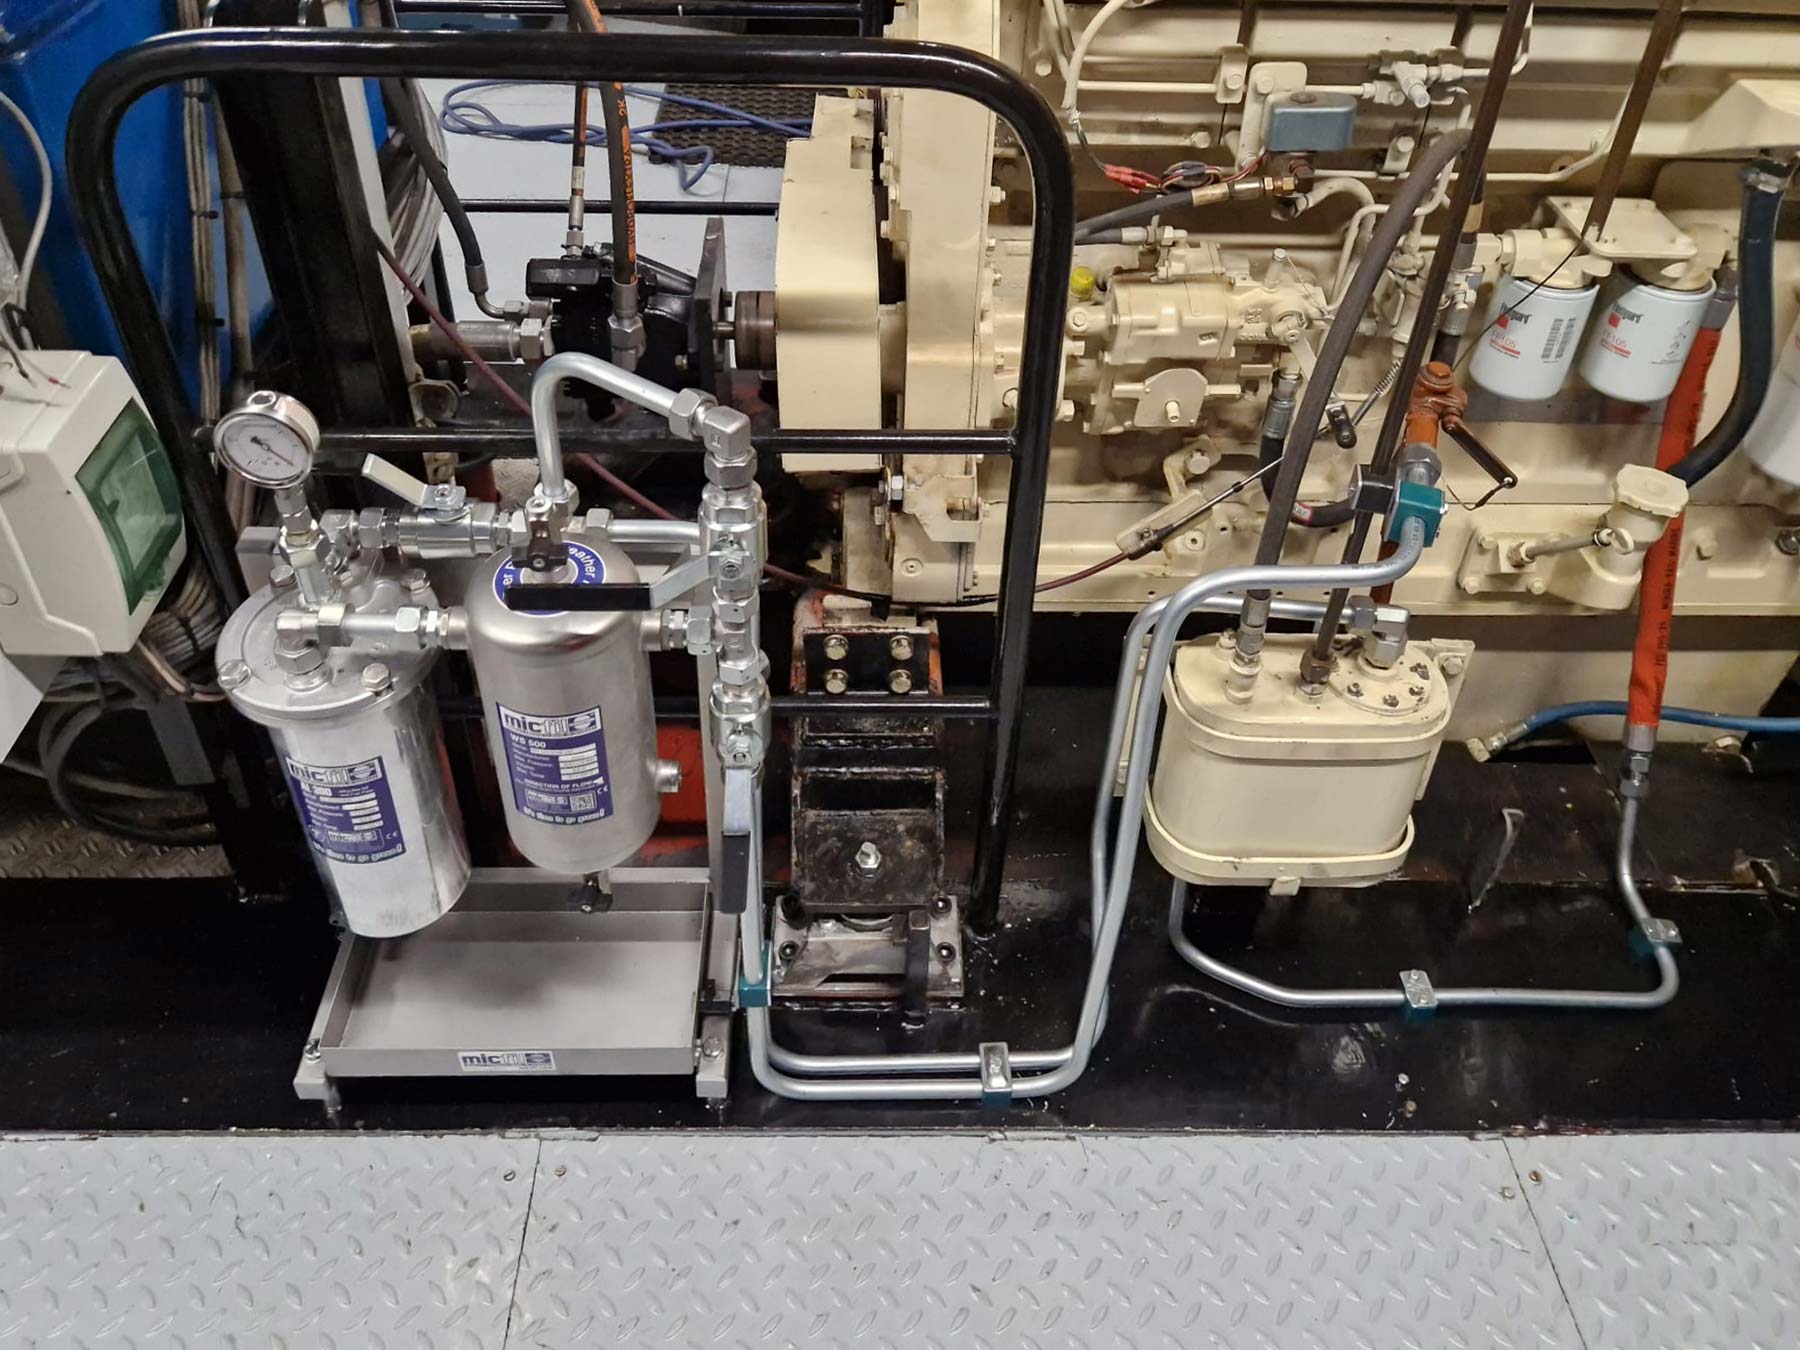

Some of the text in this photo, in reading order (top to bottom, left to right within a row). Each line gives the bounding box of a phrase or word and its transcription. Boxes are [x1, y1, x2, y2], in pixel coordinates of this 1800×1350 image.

[503, 713, 569, 737] micfil
[528, 739, 546, 748] 500
[290, 763, 350, 784] micfil
[462, 1053, 528, 1066] micfil
